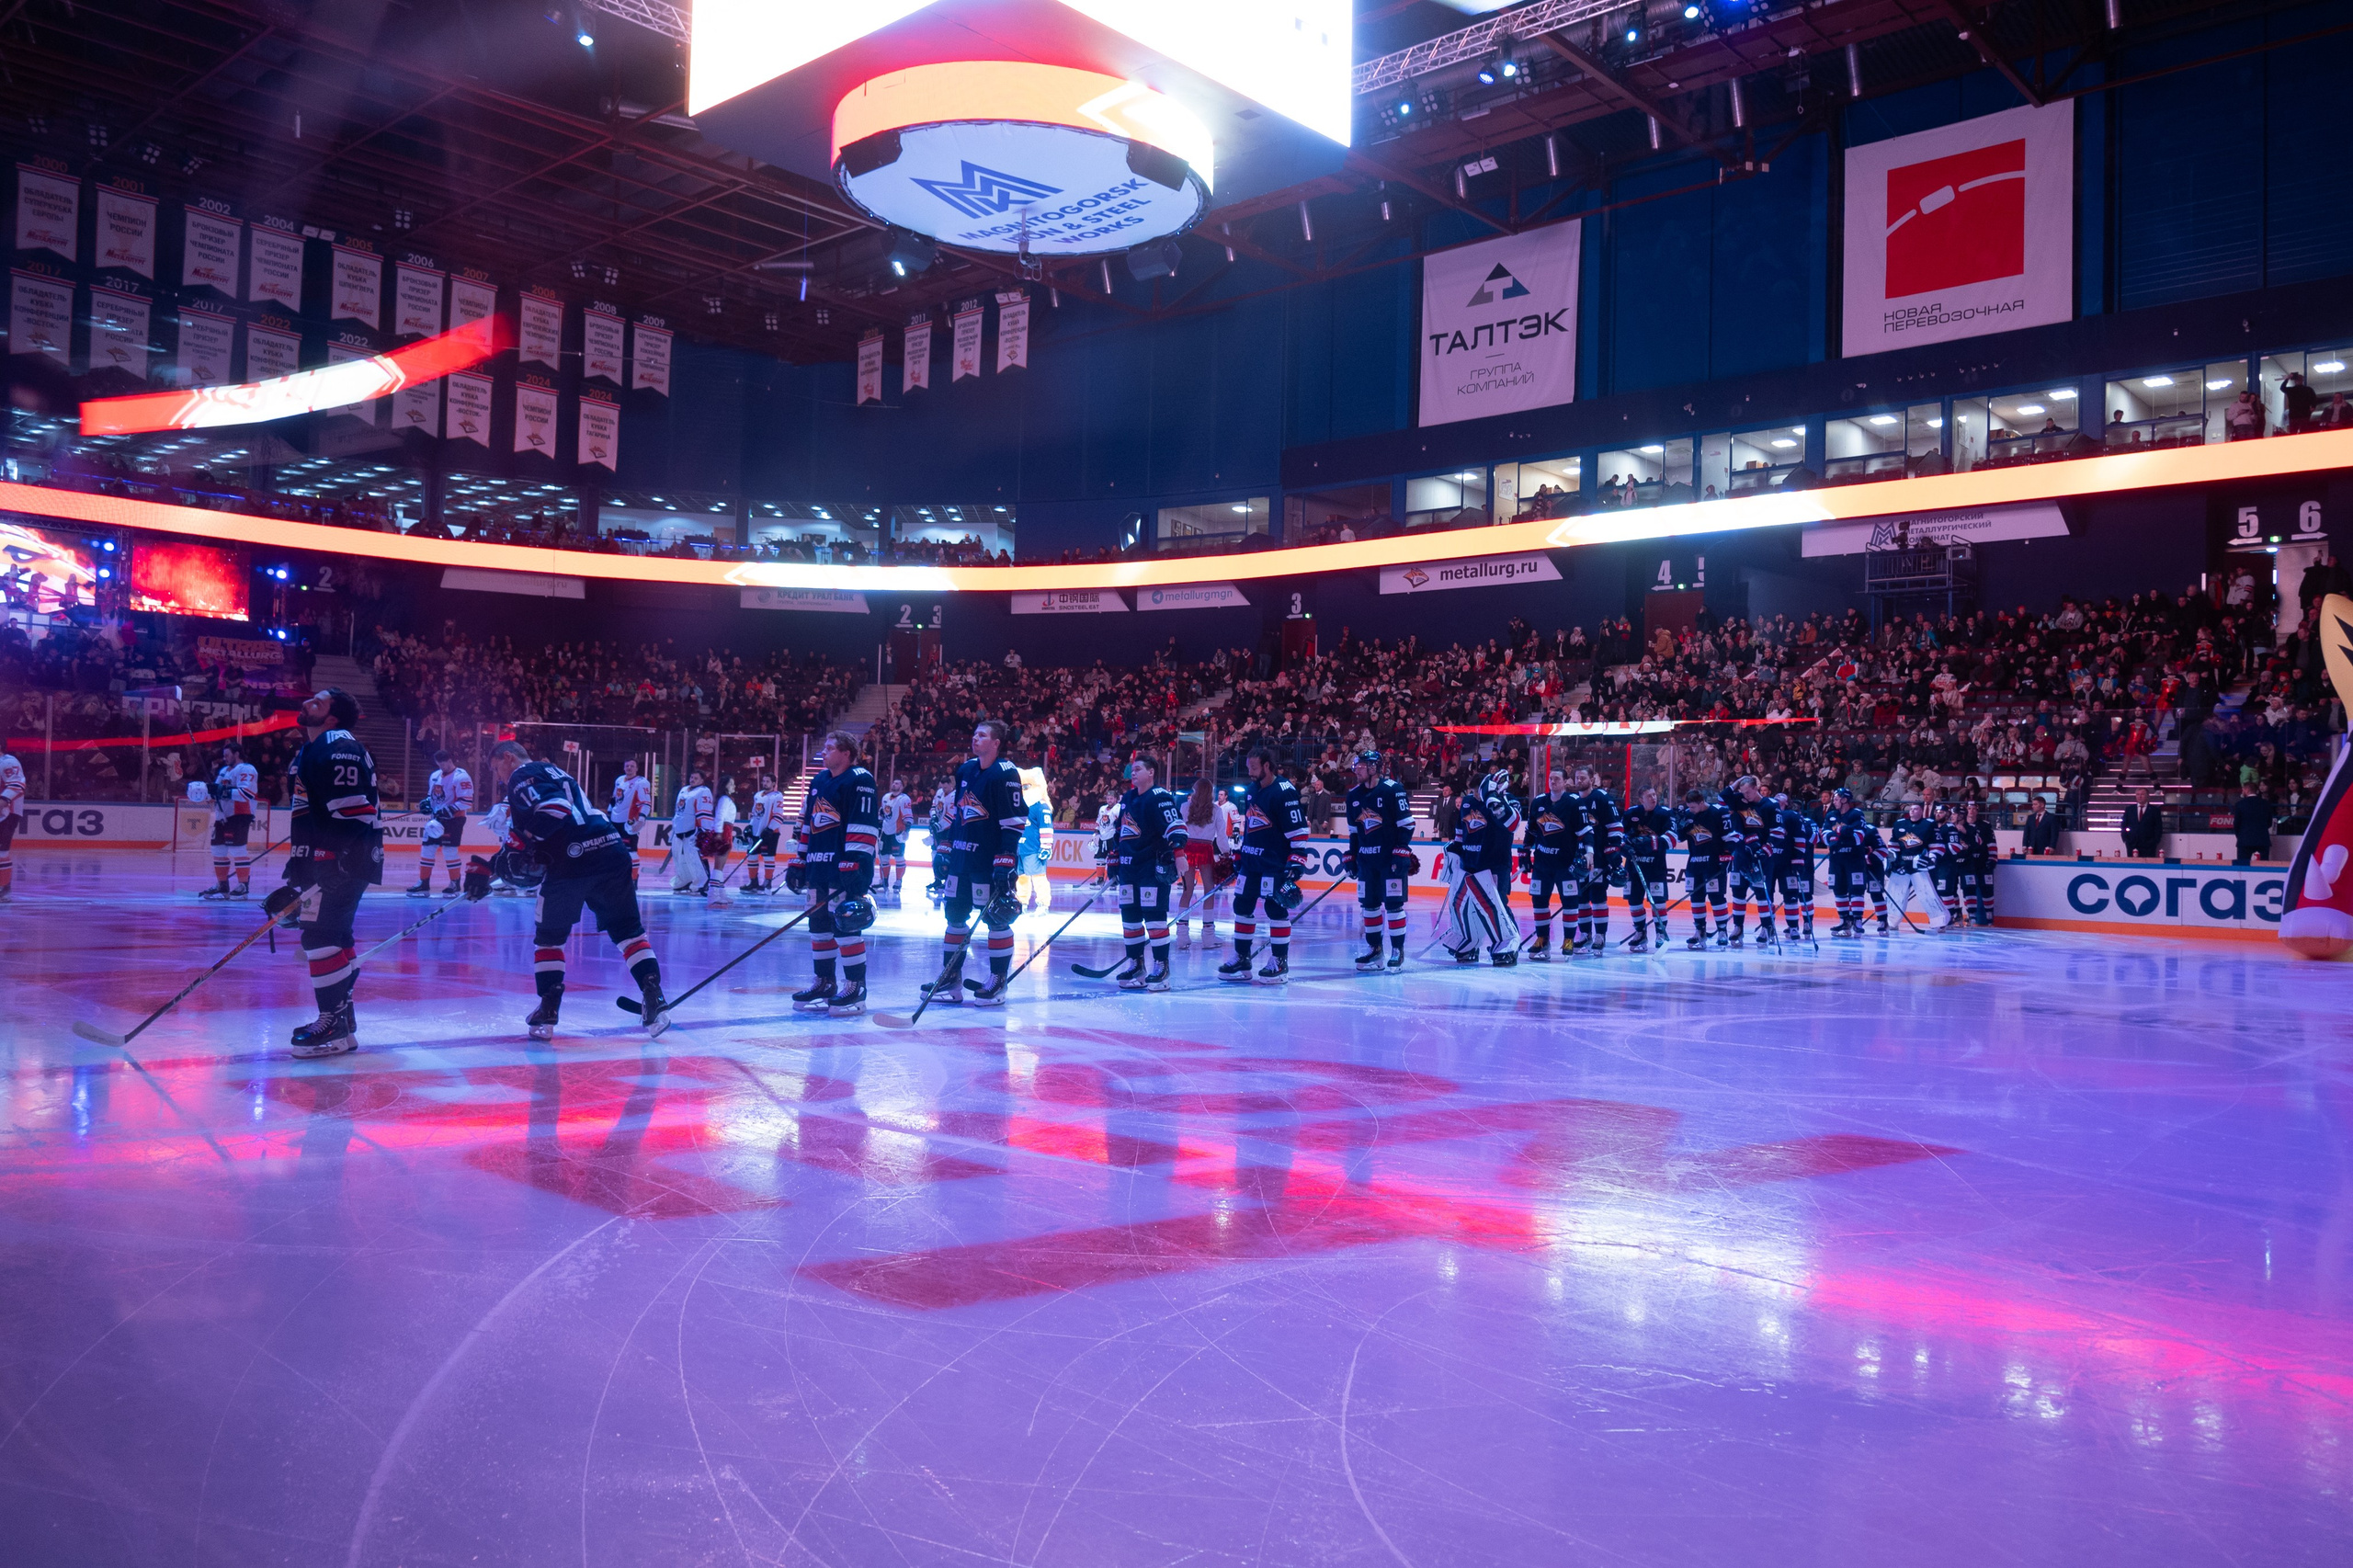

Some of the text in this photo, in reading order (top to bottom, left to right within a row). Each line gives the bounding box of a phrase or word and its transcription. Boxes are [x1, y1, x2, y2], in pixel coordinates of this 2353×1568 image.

[33, 154, 68, 174] 2000
[112, 176, 145, 193] 2001
[24, 187, 74, 204] ОБЛАДАТЕЛЬ
[24, 197, 73, 214] СУПЕРКУБКА
[199, 197, 231, 215] 2002
[958, 178, 1151, 241] MAGNITOGORSK
[1081, 198, 1153, 224] STEEL
[32, 209, 64, 222] ЕВРОПЫ
[107, 210, 147, 227] ЧЕМПИОН
[109, 222, 143, 237] РОССИИ
[191, 221, 234, 238] БРОНЗОВЫЙ
[264, 215, 294, 232] 2004
[1051, 216, 1144, 244] WORKS
[190, 240, 235, 257] ЧЕМПИОНАТА
[256, 238, 300, 255] СЕРЕБРЯНЫЙ
[345, 236, 373, 251] 2005
[198, 252, 225, 264] РОССИИ
[407, 253, 434, 268] 2006
[263, 267, 290, 278] РОССИИ
[337, 262, 377, 278] ОБЛАДАТЕЛЬ
[463, 267, 489, 281] 2007
[105, 276, 140, 293] 2017
[347, 273, 367, 283] КУБКА
[402, 276, 438, 290] БРОНЗОВЫЙ
[17, 285, 67, 302] ОБЛАДАТЕЛЬ
[400, 292, 438, 307] ЧЕМПИОНАТА
[30, 299, 54, 309] КУБКА
[97, 301, 145, 317] СЕРЕБРЯНЫЙ
[407, 302, 430, 313] РОССИИ
[459, 298, 488, 311] ЧЕМПИОН
[594, 301, 617, 314] 2008
[961, 299, 978, 312] 2012
[14, 304, 69, 322] КОНФЕРЕНЦИИ
[460, 307, 485, 319] РОССИИ
[911, 313, 926, 325] 2011
[1884, 302, 1942, 322] НОВАЯ
[1884, 300, 2025, 333] ПЕРЕВОЗОЧНАЯ
[260, 314, 291, 331] 2022
[643, 315, 665, 328] 2009
[105, 332, 134, 344] РОССИИ
[1429, 307, 1570, 356] ТАЛТЭК
[339, 332, 369, 347] 2022
[1470, 361, 1522, 380] ГРУППА
[526, 374, 551, 387] 2024
[1457, 370, 1535, 395] КОМПАНИЙ
[589, 389, 612, 402] 2024
[522, 404, 551, 415] ЧЕМПИОН
[525, 414, 549, 424] РОССИИ
[2238, 506, 2259, 538] 5
[2299, 500, 2322, 532] 6
[318, 566, 333, 590] 2
[1440, 562, 1537, 581] metallurg.ru
[1657, 560, 1671, 585] 4
[777, 590, 855, 603] КРЕДИТ УРАЛ БАНК
[1059, 593, 1100, 603] 中钢国际
[1165, 590, 1233, 601] metallurgmgn
[1291, 592, 1302, 614] 3
[900, 604, 912, 624] 2
[331, 753, 361, 763] FONBET
[240, 773, 256, 782] 27
[334, 766, 358, 786] 29
[519, 786, 541, 807] 14
[857, 785, 876, 794] FONBET
[861, 796, 872, 813] 11
[1013, 791, 1020, 807] 9
[1377, 797, 1382, 808] C
[1592, 800, 1597, 810] A
[1163, 808, 1178, 823] 89
[1290, 809, 1302, 824] 91
[582, 835, 606, 848] КРЕДИТ
[952, 840, 980, 852] FONBET
[290, 846, 310, 858] BET
[1241, 845, 1264, 856] FONBET
[1359, 846, 1381, 855] FONBET
[1537, 844, 1560, 855] FONBET
[1120, 856, 1132, 865] BET
